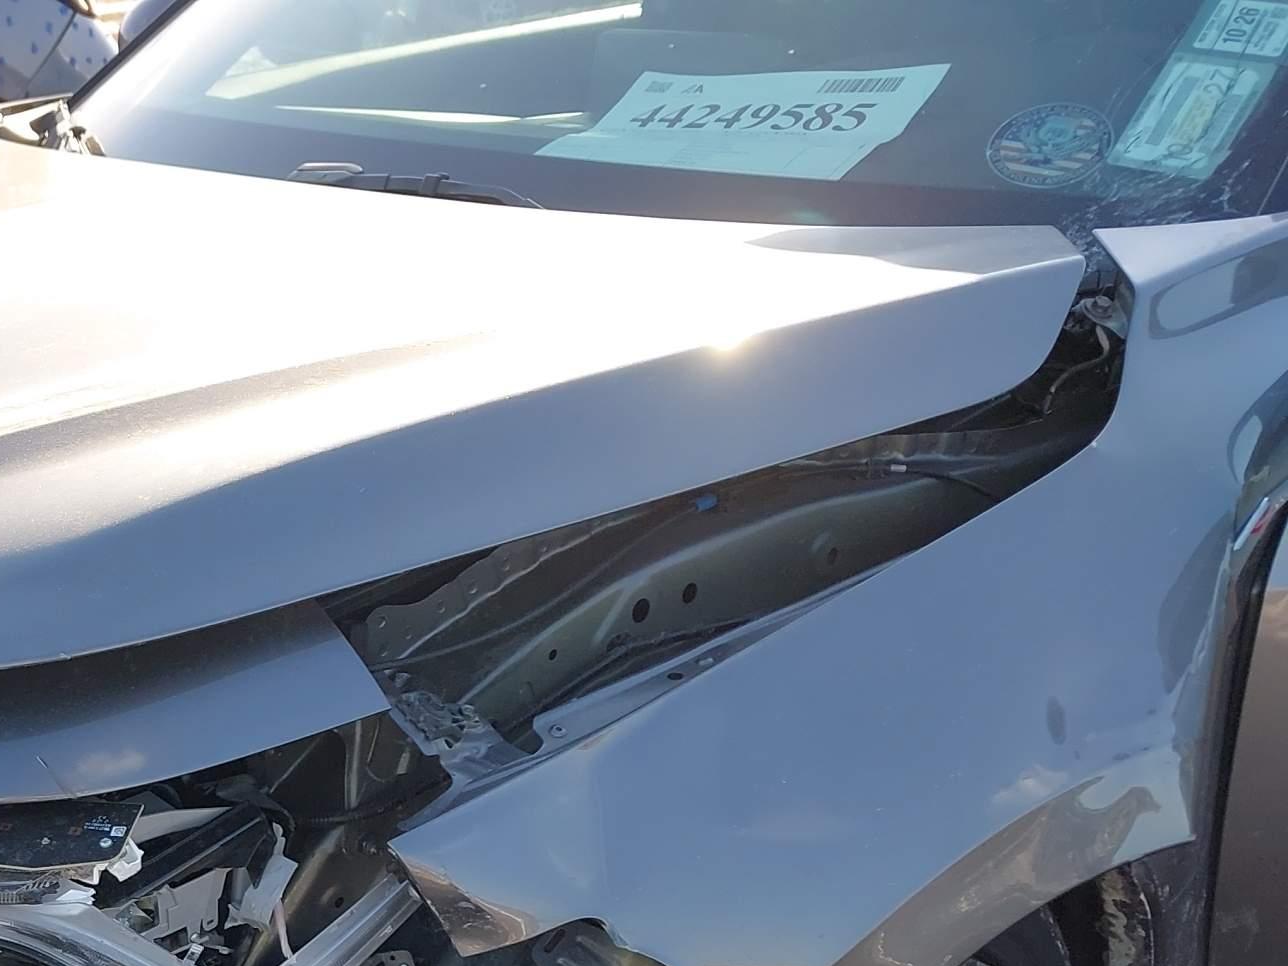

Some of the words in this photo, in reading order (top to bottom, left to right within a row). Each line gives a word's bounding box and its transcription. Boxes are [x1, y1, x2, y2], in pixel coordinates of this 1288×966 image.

[1233, 6, 1261, 25] 26
[1222, 28, 1247, 44] 10
[629, 102, 880, 132] 44249585
